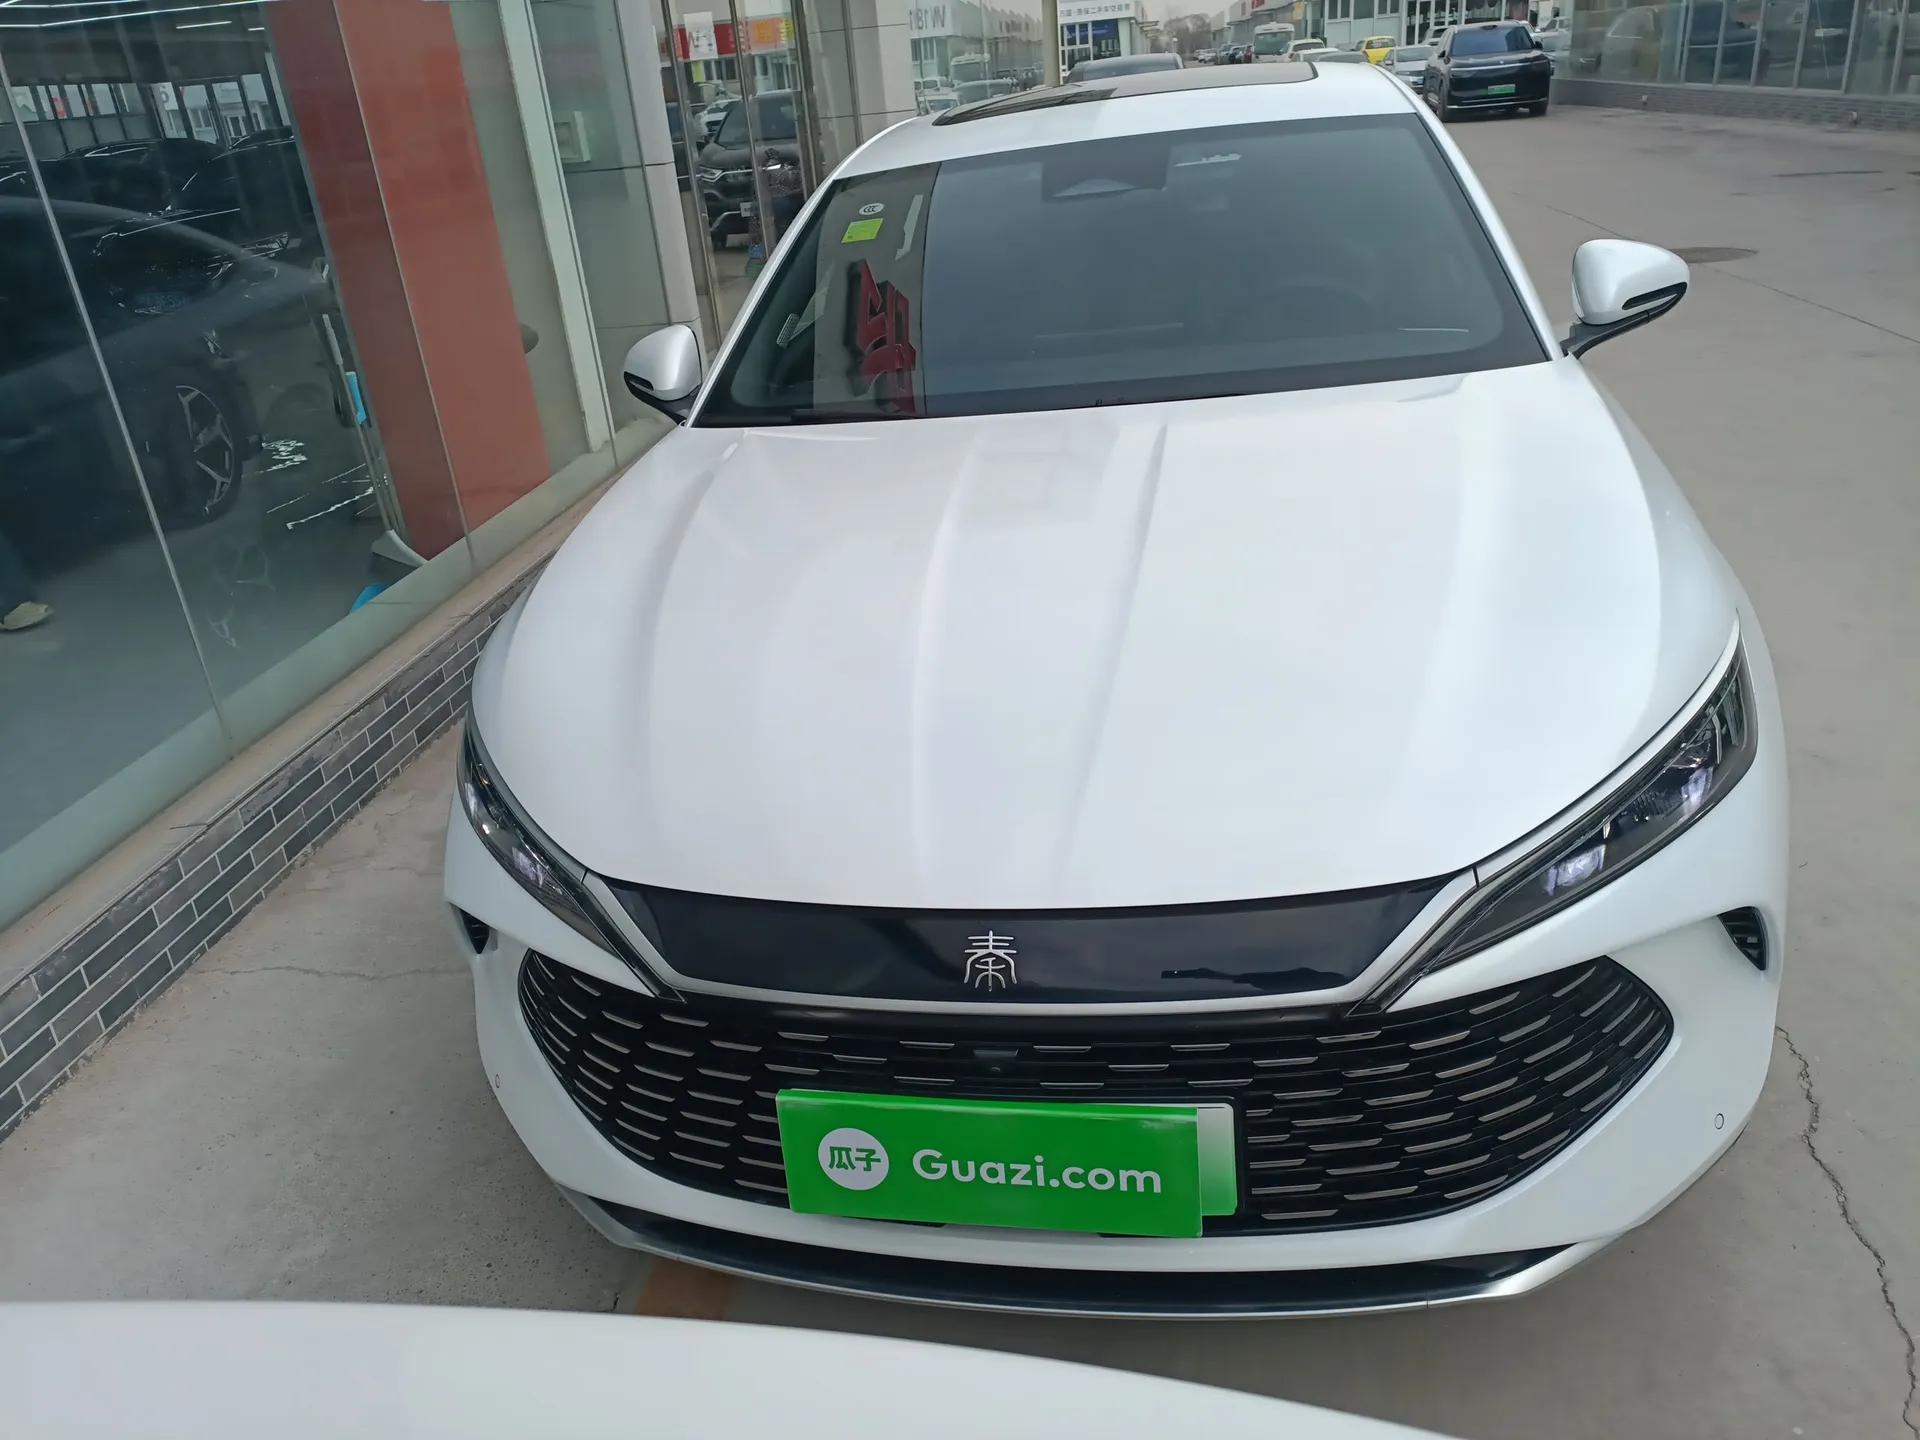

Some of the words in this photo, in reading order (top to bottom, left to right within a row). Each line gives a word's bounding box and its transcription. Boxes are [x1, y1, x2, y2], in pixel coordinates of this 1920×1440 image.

[964, 930, 1018, 992] 秦
[828, 1145, 881, 1172] 瓜子
[912, 1148, 1162, 1194] Guazi.com
